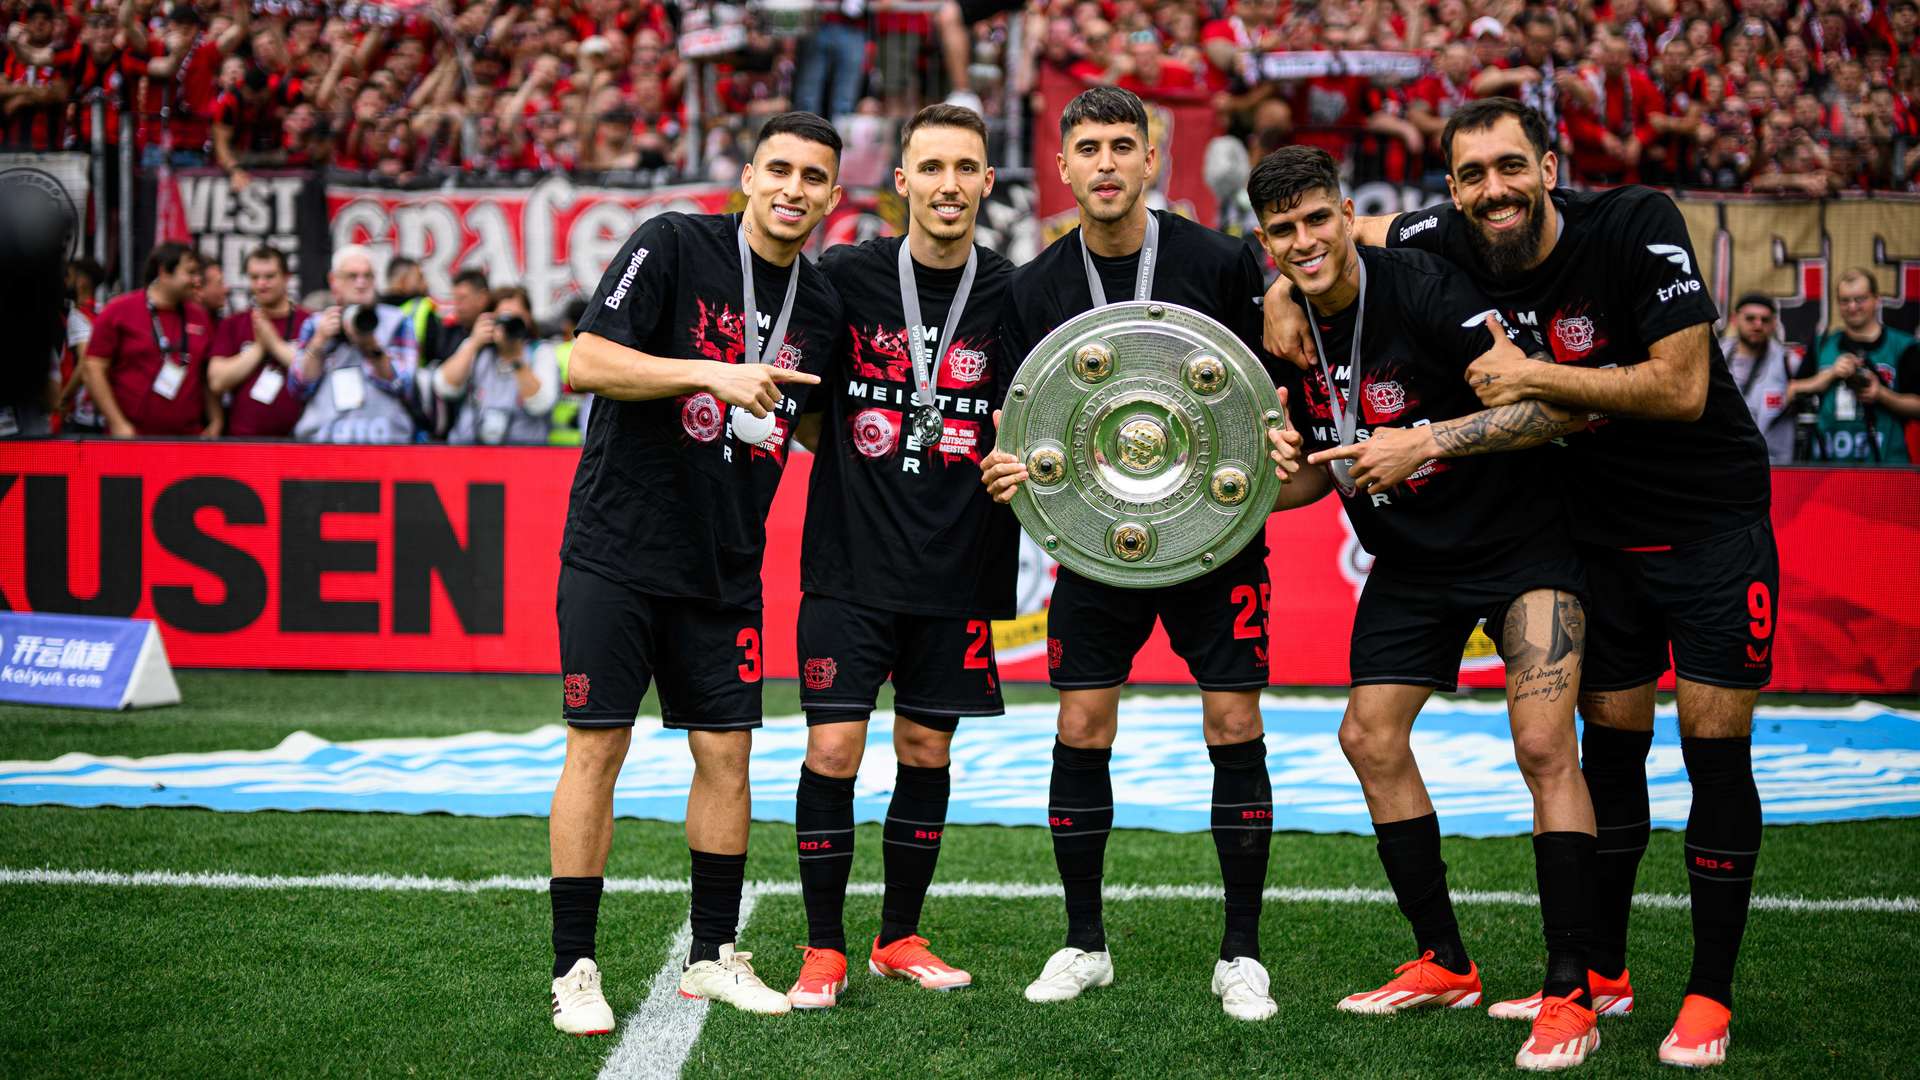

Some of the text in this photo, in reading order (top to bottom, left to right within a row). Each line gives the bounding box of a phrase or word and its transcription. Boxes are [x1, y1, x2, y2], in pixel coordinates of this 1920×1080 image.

[604, 247, 650, 310] Barmenia
[1656, 279, 1701, 302] trive
[912, 324, 928, 381] BUNDESLIGA
[848, 380, 989, 415] MEISTER
[940, 435, 976, 446] EUTSCHER
[0, 474, 505, 635] USEN
[1231, 583, 1271, 640] 25
[1747, 581, 1772, 639] 9
[11, 635, 117, 671] 开云体育
[736, 627, 762, 683] 3
[964, 619, 994, 670] 2
[1695, 856, 1735, 870] B04
